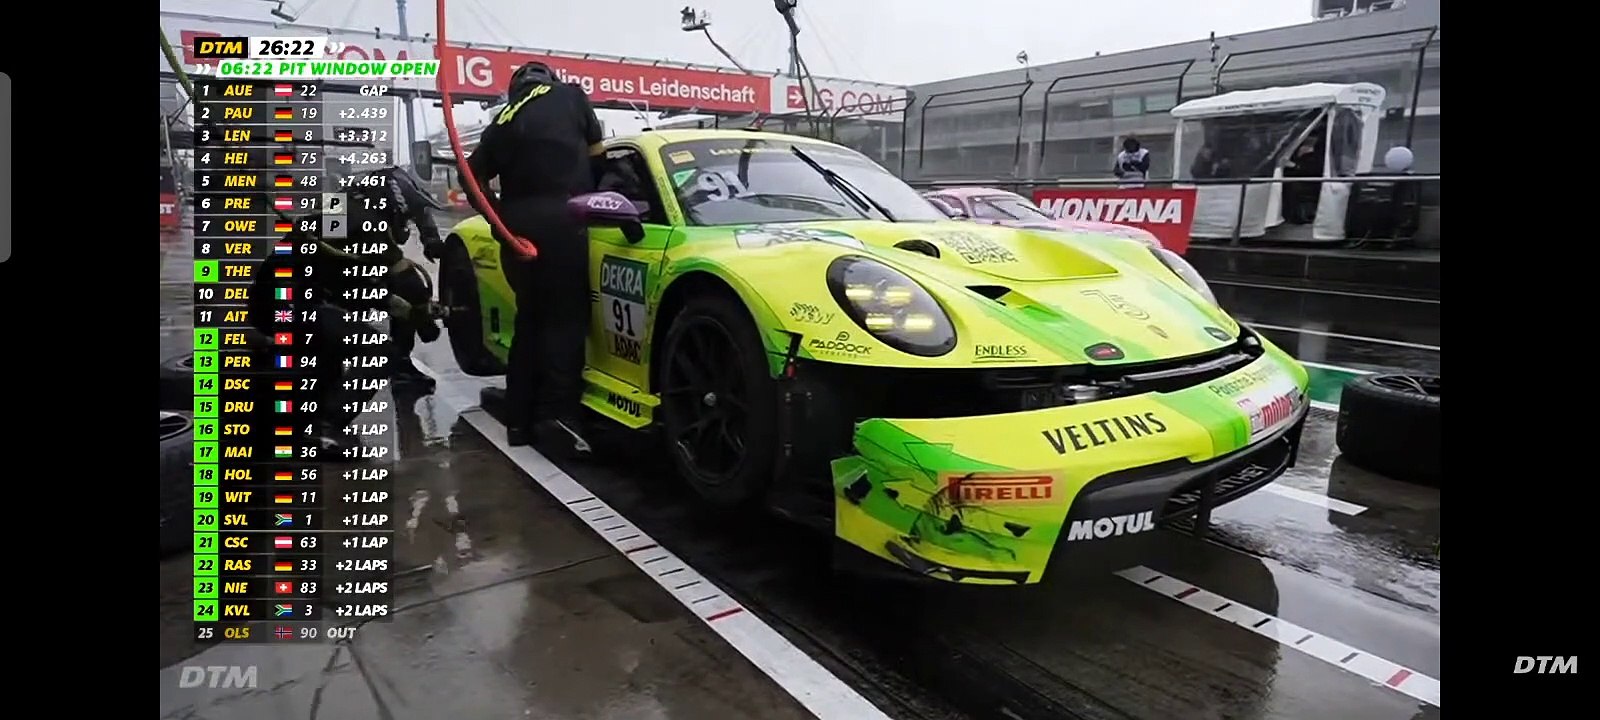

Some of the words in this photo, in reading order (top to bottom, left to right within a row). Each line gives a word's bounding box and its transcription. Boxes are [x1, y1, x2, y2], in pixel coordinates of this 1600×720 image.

[456, 54, 494, 87] IG
[600, 77, 634, 94] aus
[639, 76, 756, 104] Leidenschaft
[1039, 197, 1183, 224] MONTANA
[601, 262, 645, 298] DEKRA
[612, 298, 636, 338] 91
[808, 338, 873, 356] PADDOCK
[974, 344, 1028, 357] ENDLESS
[607, 391, 643, 419] MOTUL
[1040, 411, 1167, 456] VELTINS
[1066, 510, 1157, 542] MOTUL
